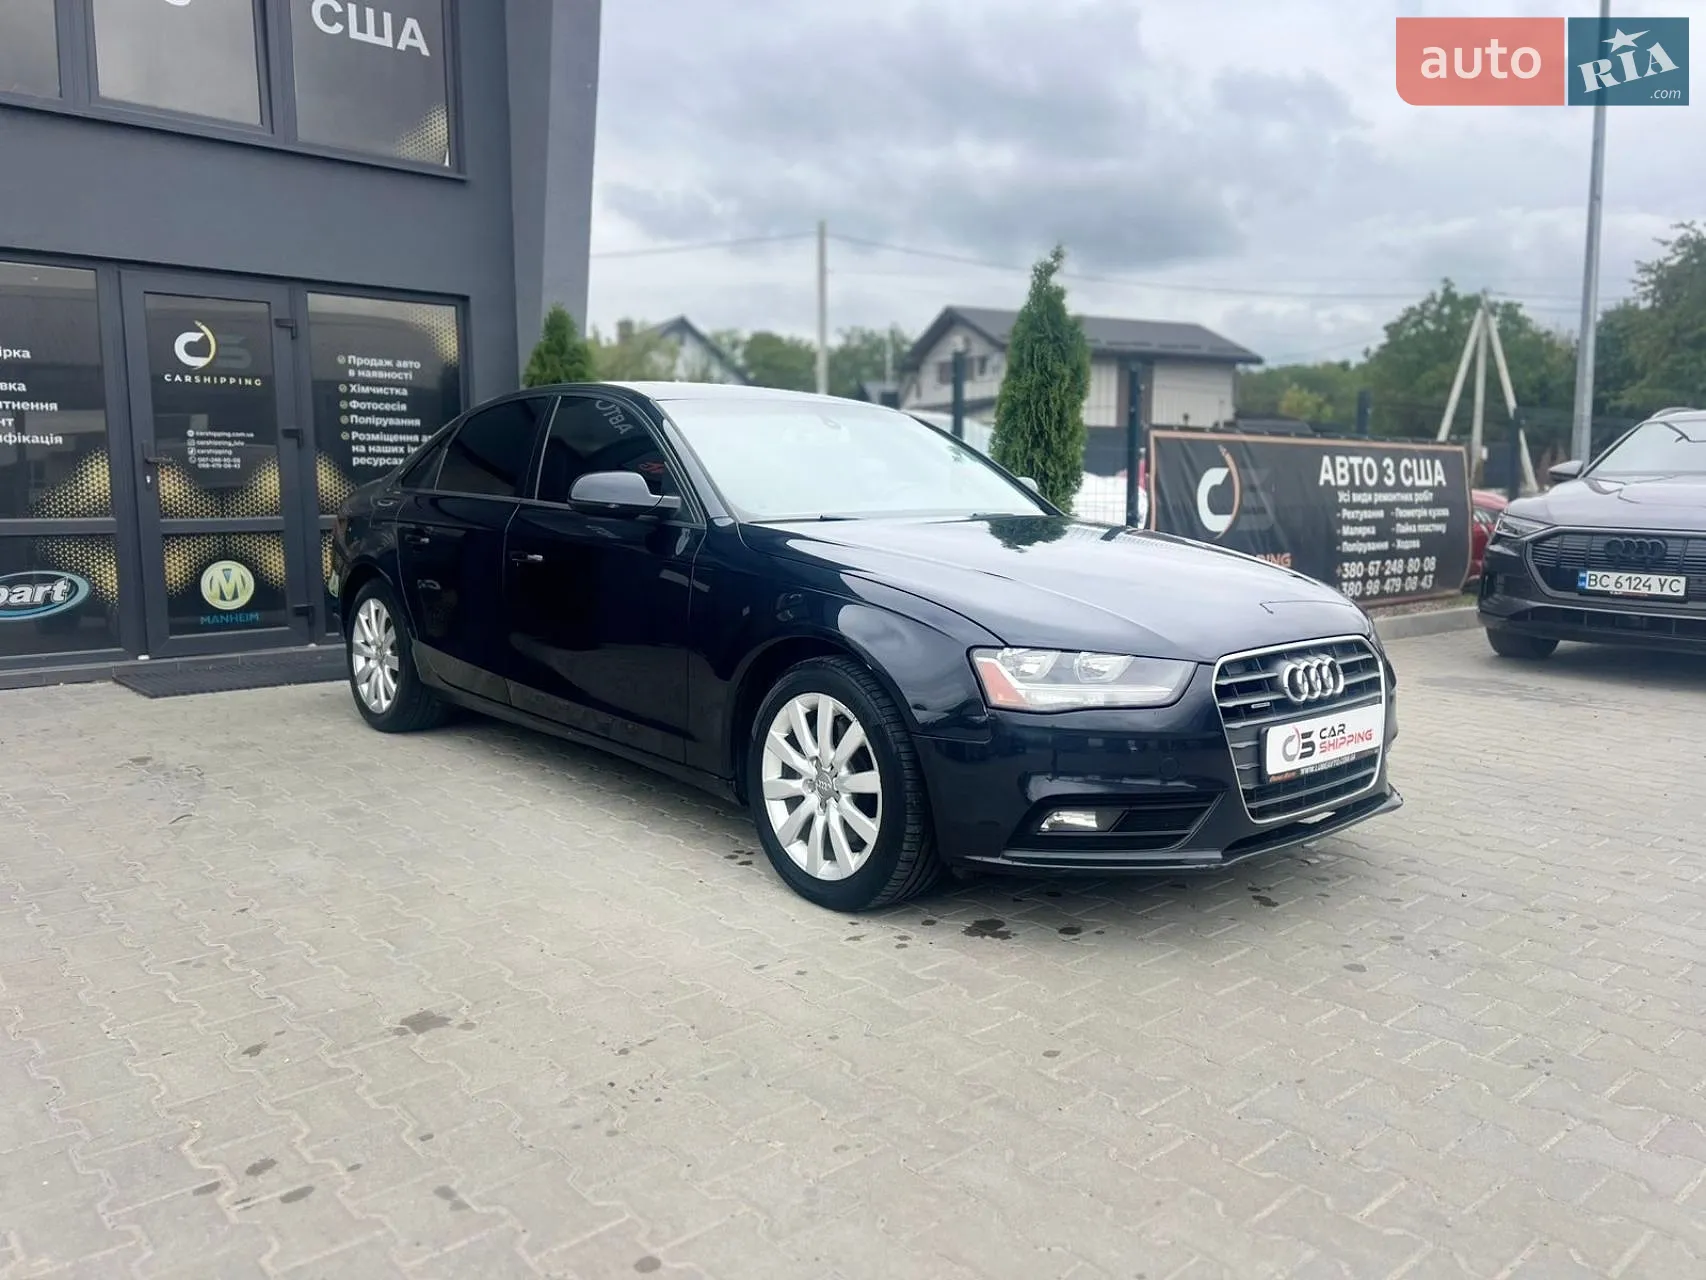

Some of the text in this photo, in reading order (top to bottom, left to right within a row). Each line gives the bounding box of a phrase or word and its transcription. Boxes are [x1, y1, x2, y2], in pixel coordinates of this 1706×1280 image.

[311, 0, 430, 56] США
[348, 355, 421, 370] Продаж авто
[164, 374, 262, 386] CARSHIPPING
[348, 369, 413, 380] в наявності
[349, 384, 408, 396] Хімчистка
[349, 399, 407, 412] Фотосесія
[350, 414, 421, 428] Полірування
[0, 432, 63, 445] фікація
[351, 431, 420, 443] Розміщення
[352, 445, 366, 453] на
[368, 445, 405, 454] наших
[1318, 455, 1379, 487] АВТО
[1400, 458, 1447, 487] США
[1587, 573, 1681, 593] BC 6124 YC
[200, 612, 260, 625] MANHEIM
[1319, 723, 1347, 740] CAR
[1319, 728, 1374, 754] SHIPPING
